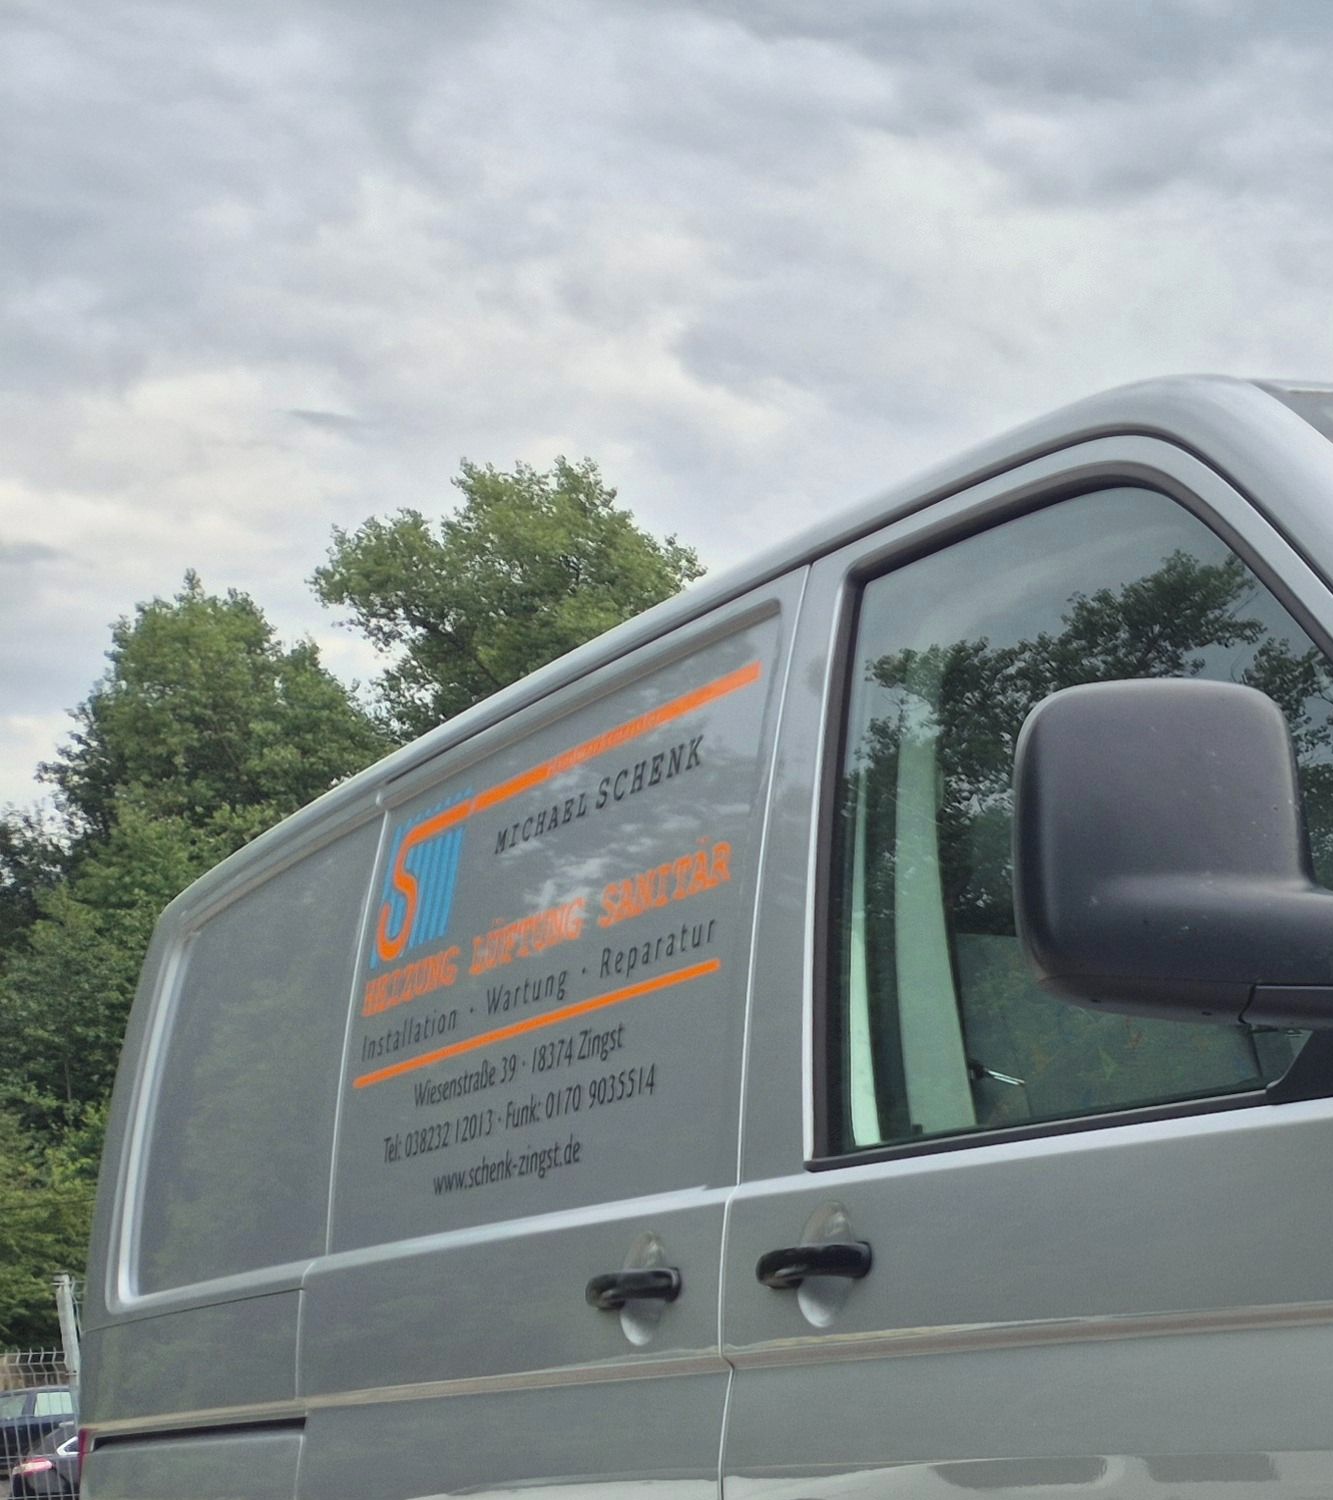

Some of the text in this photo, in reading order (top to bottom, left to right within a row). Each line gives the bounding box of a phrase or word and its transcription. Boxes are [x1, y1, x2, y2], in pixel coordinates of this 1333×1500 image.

[495, 733, 704, 855] MICHAEL SCHENK
[361, 945, 461, 1018] HEIZUNG
[598, 835, 731, 929] SANITÄR
[361, 919, 716, 1063] Installation Wartung Reparatur
[405, 1119, 450, 1159] 038232
[455, 1108, 494, 1145] 12013
[505, 1092, 541, 1130] Funk:
[545, 1083, 582, 1120] 0170
[588, 1062, 656, 1111] 9035514
[414, 1021, 625, 1108] Wiesenstraße 39 18374 Zingst
[432, 1132, 582, 1196] www.schenk-zingst.de
